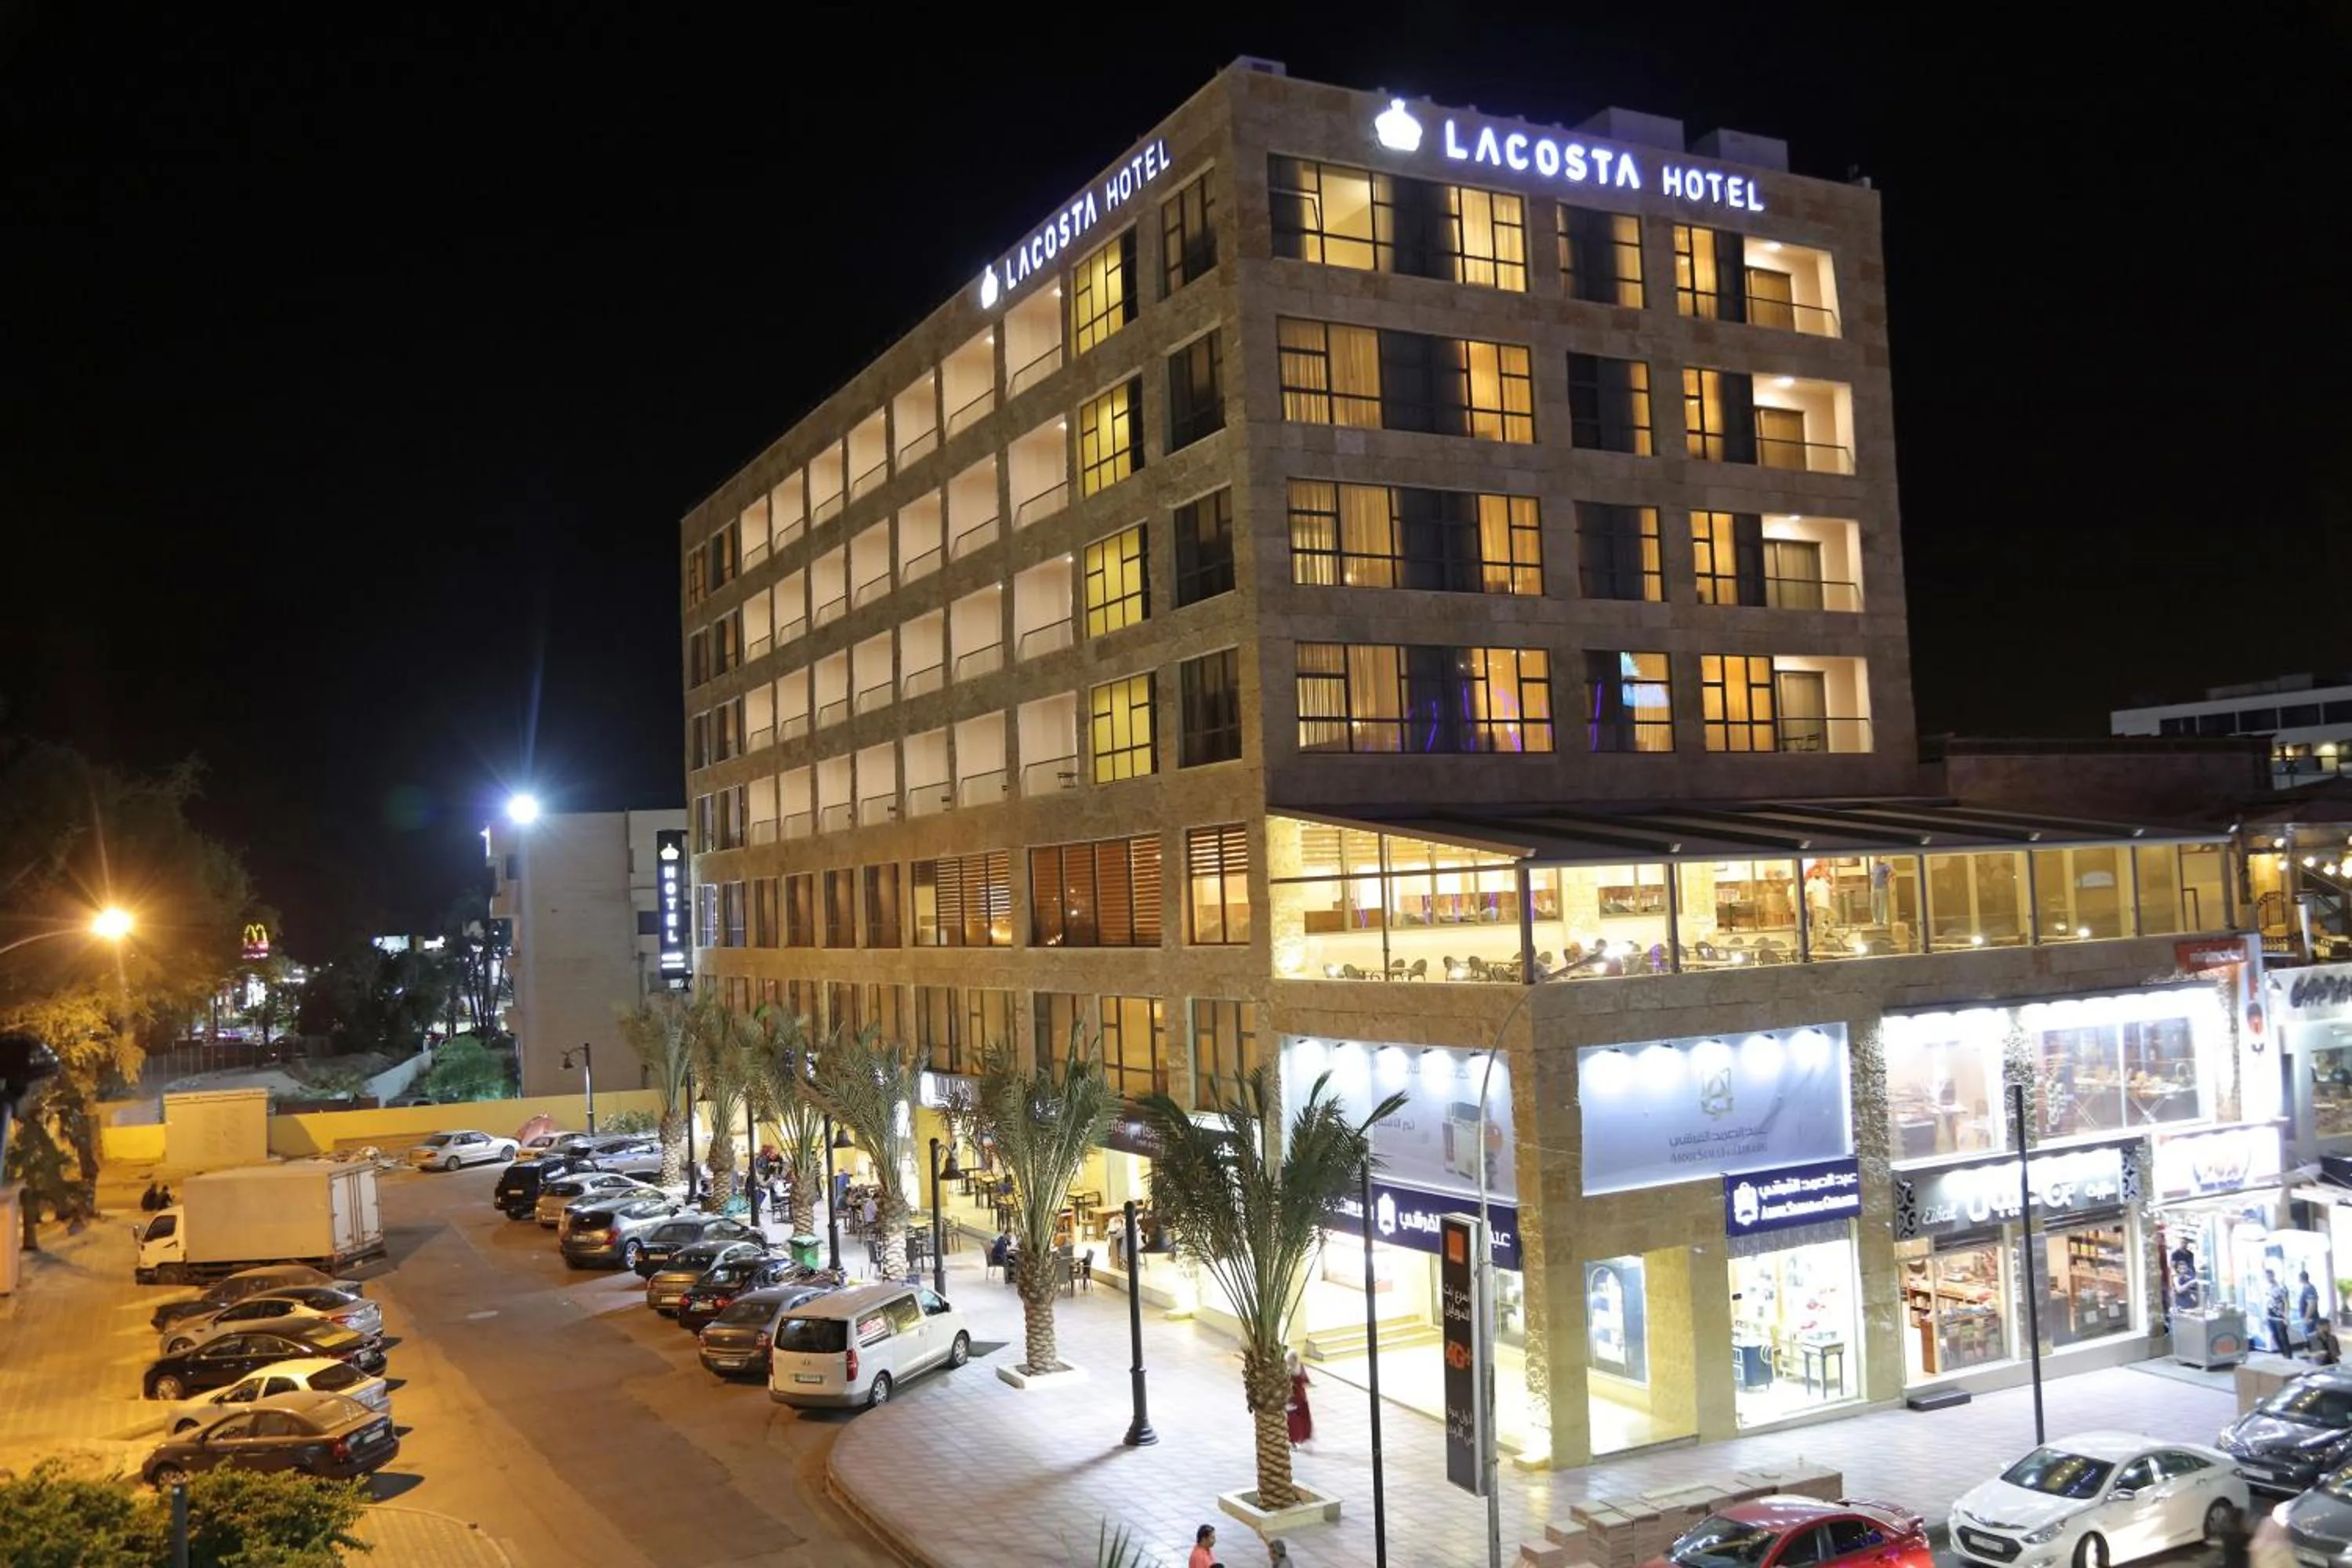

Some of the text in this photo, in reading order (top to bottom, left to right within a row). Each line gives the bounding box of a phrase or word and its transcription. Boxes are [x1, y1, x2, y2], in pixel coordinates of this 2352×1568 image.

[1445, 118, 1765, 212] LACOSTA HOTEL
[1006, 139, 1171, 290] LACOSTA HOTEL
[664, 866, 679, 944] HOTEL
